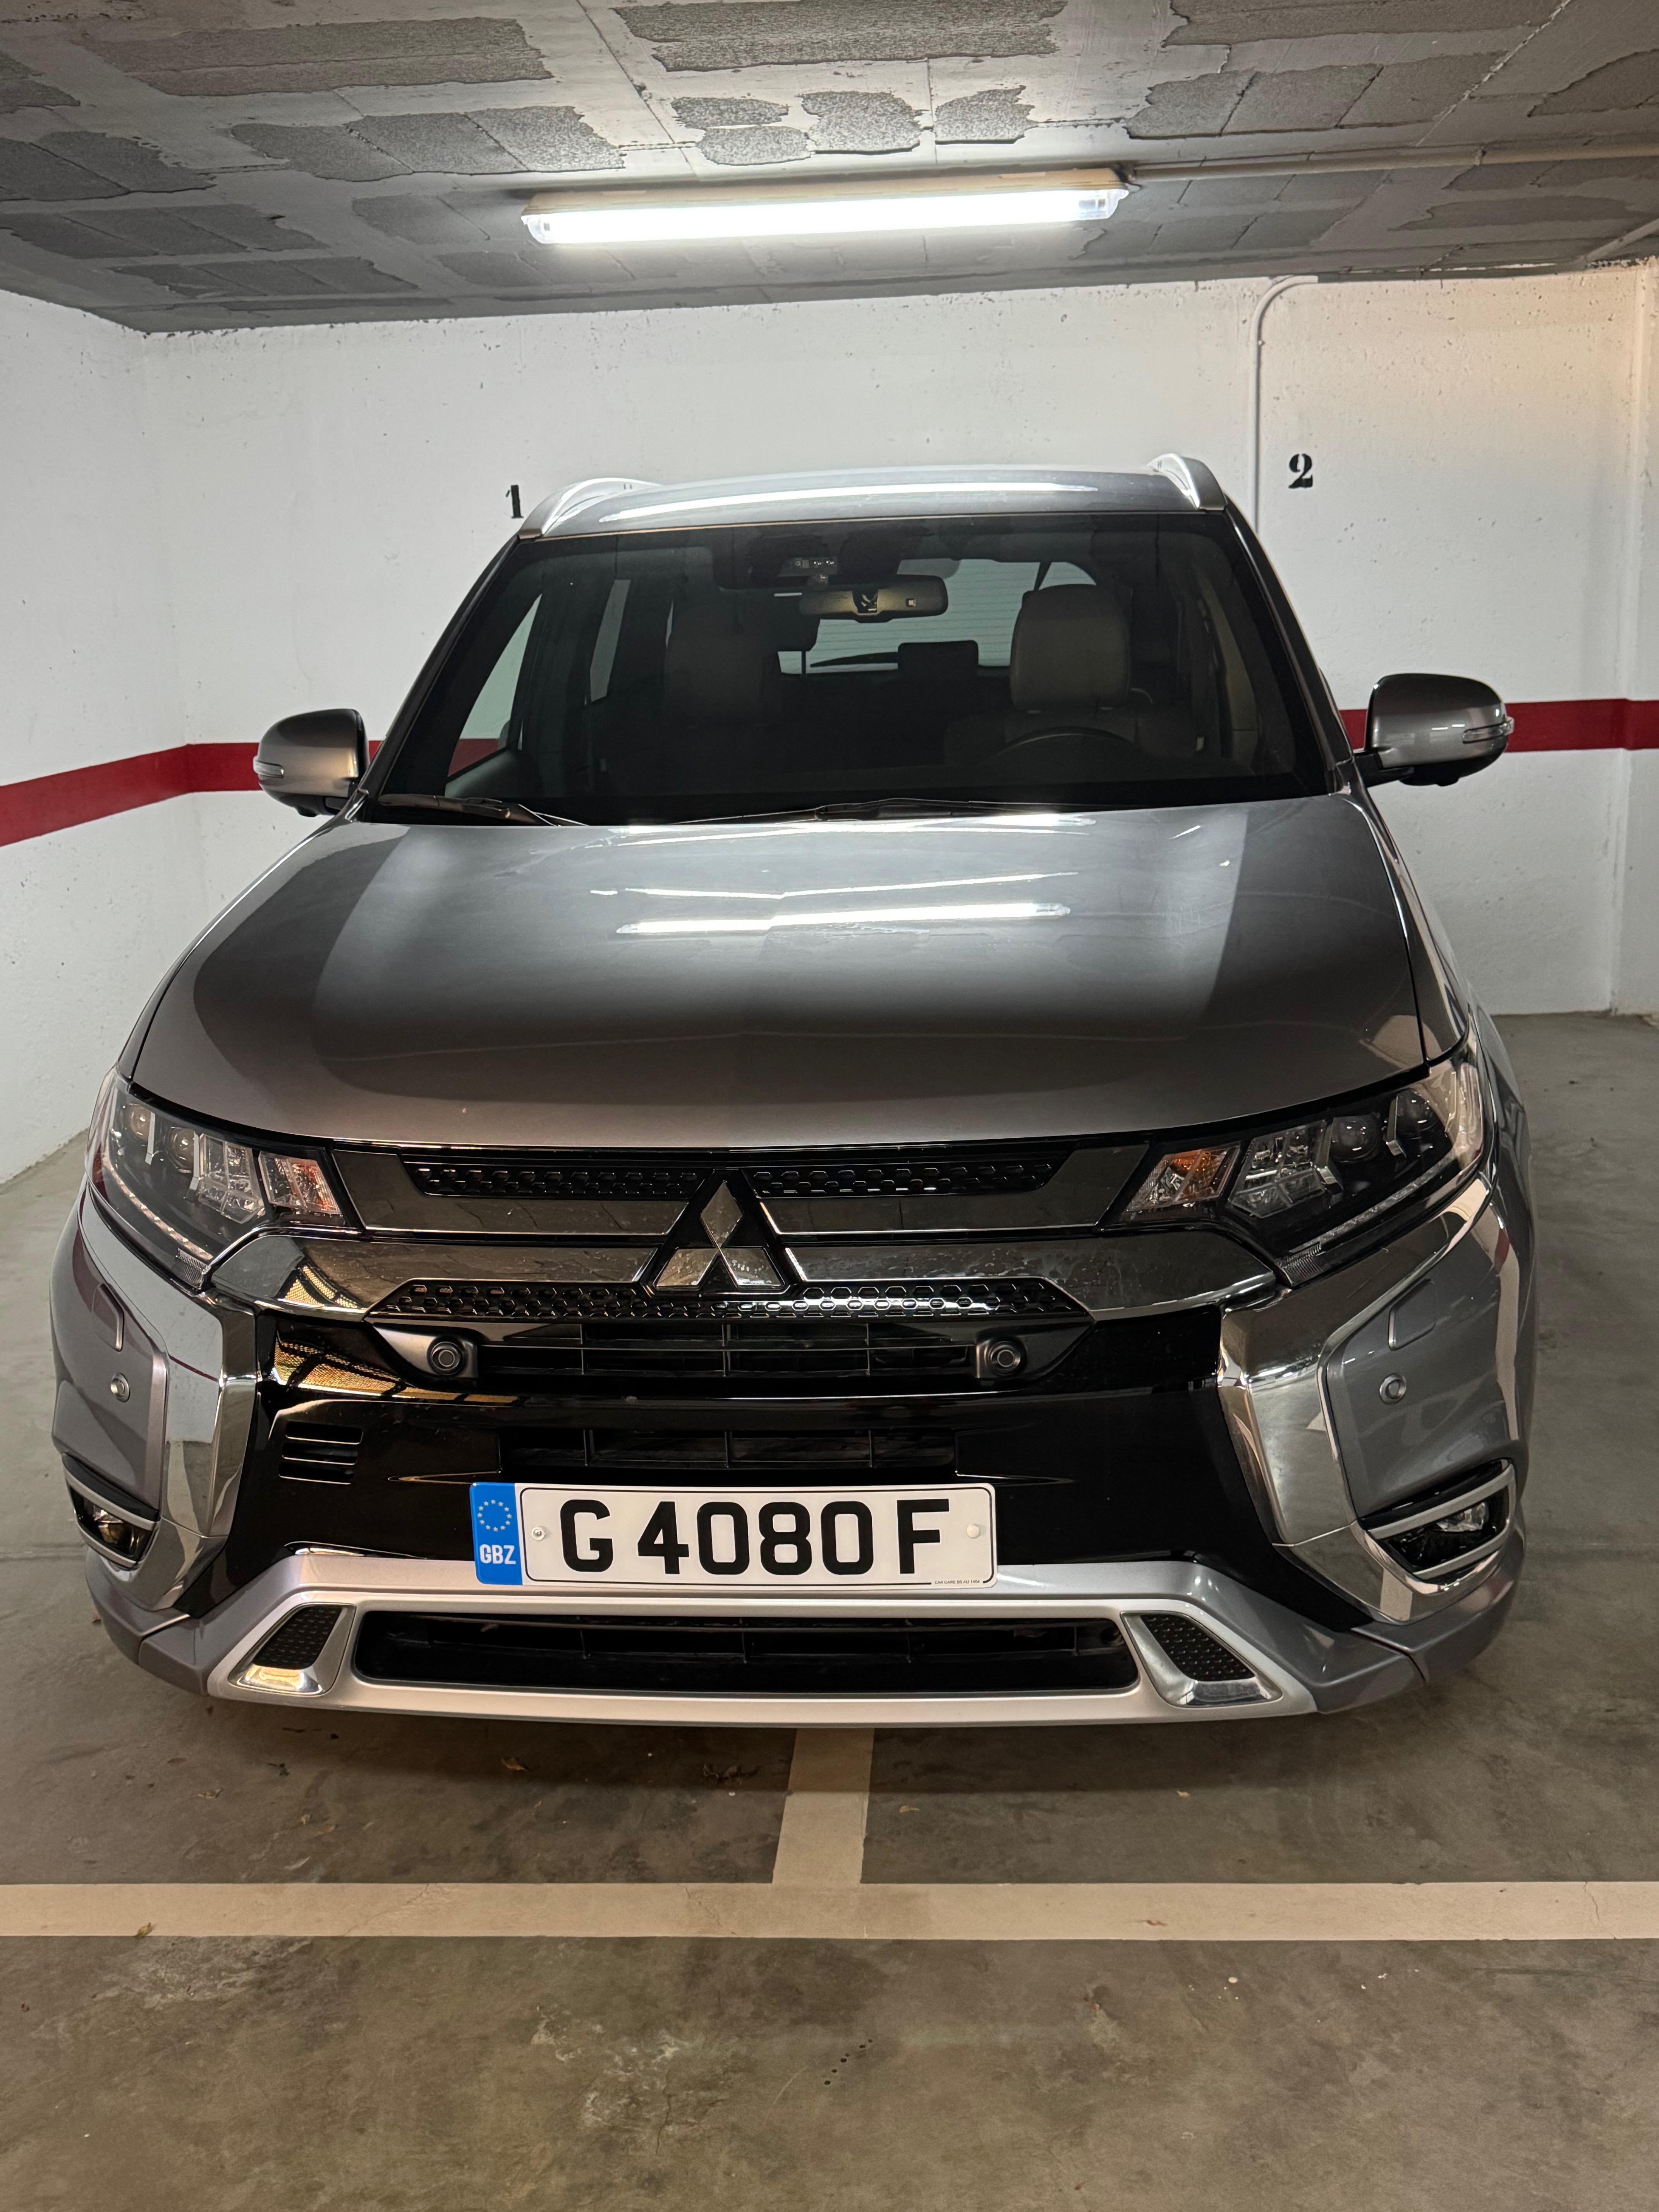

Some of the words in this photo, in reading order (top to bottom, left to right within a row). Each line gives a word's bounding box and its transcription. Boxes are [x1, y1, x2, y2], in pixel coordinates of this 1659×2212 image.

[1288, 453, 1313, 489] 2
[505, 484, 524, 519] 1
[560, 1499, 613, 1572] G
[637, 1501, 874, 1575] 4080
[896, 1498, 949, 1574] F
[479, 1544, 517, 1565] GBZ
